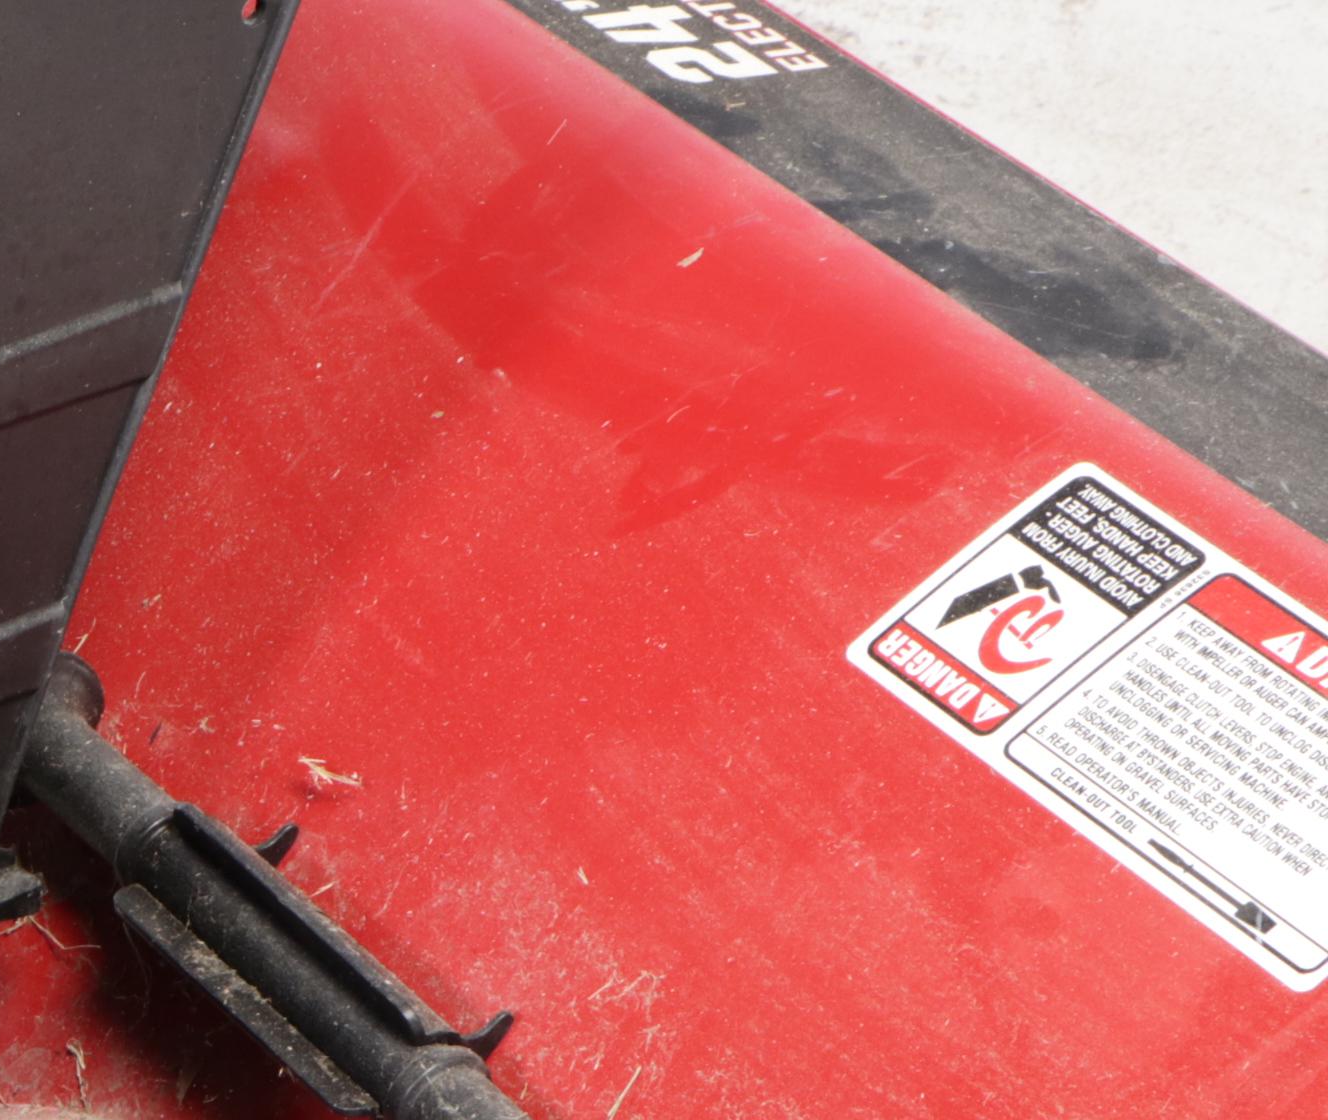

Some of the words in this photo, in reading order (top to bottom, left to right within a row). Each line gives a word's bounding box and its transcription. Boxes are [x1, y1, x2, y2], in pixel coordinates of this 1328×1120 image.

[682, 0, 830, 72] ELECT
[1045, 513, 1100, 552] AUGER
[1054, 494, 1098, 525] FEET
[1075, 483, 1118, 513] AWAY.
[1107, 504, 1173, 550] CLOTHING
[1019, 520, 1065, 554] FROM
[1053, 544, 1107, 583] INJURY
[1087, 516, 1145, 557] HANDS,
[1089, 543, 1162, 594] ROTATING
[1135, 548, 1180, 581] KEEP
[1162, 542, 1198, 568] AND
[1096, 574, 1145, 608] AVOID
[874, 627, 983, 710] DANGER
[1153, 643, 1179, 661] USE
[1173, 656, 1232, 698] CLEAN-OUT
[1227, 694, 1258, 716] TOOL
[1253, 712, 1274, 727] TO
[1266, 721, 1313, 754] UNCLOG
[1172, 629, 1201, 650] WITH
[1195, 645, 1244, 679] IMPELLER
[1238, 674, 1258, 689] OR
[1252, 684, 1290, 711] AUGER
[1284, 706, 1311, 725] CAN
[1186, 618, 1217, 640] KEEP
[1210, 635, 1245, 659] AWAY
[1239, 655, 1274, 679] FROM
[1268, 674, 1321, 712] ROTATING
[1106, 680, 1174, 728] UNCLOGGING
[1168, 723, 1190, 739] OR
[1183, 734, 1242, 776] SERVICING
[1121, 669, 1169, 703] HANDLES
[1162, 697, 1194, 721] UNTIL
[1189, 717, 1213, 734] ALL
[1208, 729, 1253, 762] MOVING
[1246, 756, 1285, 784] PARTS
[1278, 779, 1312, 803] HAVE
[1134, 658, 1189, 697] DISENGAGE
[1182, 691, 1224, 721] CLUTCH
[1253, 741, 1284, 764] STOP
[1045, 731, 1079, 757] READ
[1073, 752, 1141, 802] OPERATOR'S
[1062, 717, 1116, 756] OPERATING
[1109, 751, 1129, 766] ON
[1123, 761, 1168, 794] GRAVEL
[1089, 694, 1109, 709] TO
[1103, 704, 1139, 731] AVOID
[1134, 726, 1182, 761] THROWN
[1175, 756, 1226, 792] OBJECTS
[1268, 821, 1304, 848] NEVER
[1297, 842, 1328, 868] DIREC
[1048, 766, 1111, 813] CLEAN-OUT
[1106, 809, 1140, 834] TOOL
[1075, 705, 1129, 744] DISCHARGE
[1122, 739, 1141, 753] AT
[1192, 788, 1216, 807] USE
[1210, 801, 1247, 828] EXTRA
[1240, 823, 1286, 856] CAUTION
[1279, 851, 1314, 876] WHEN
